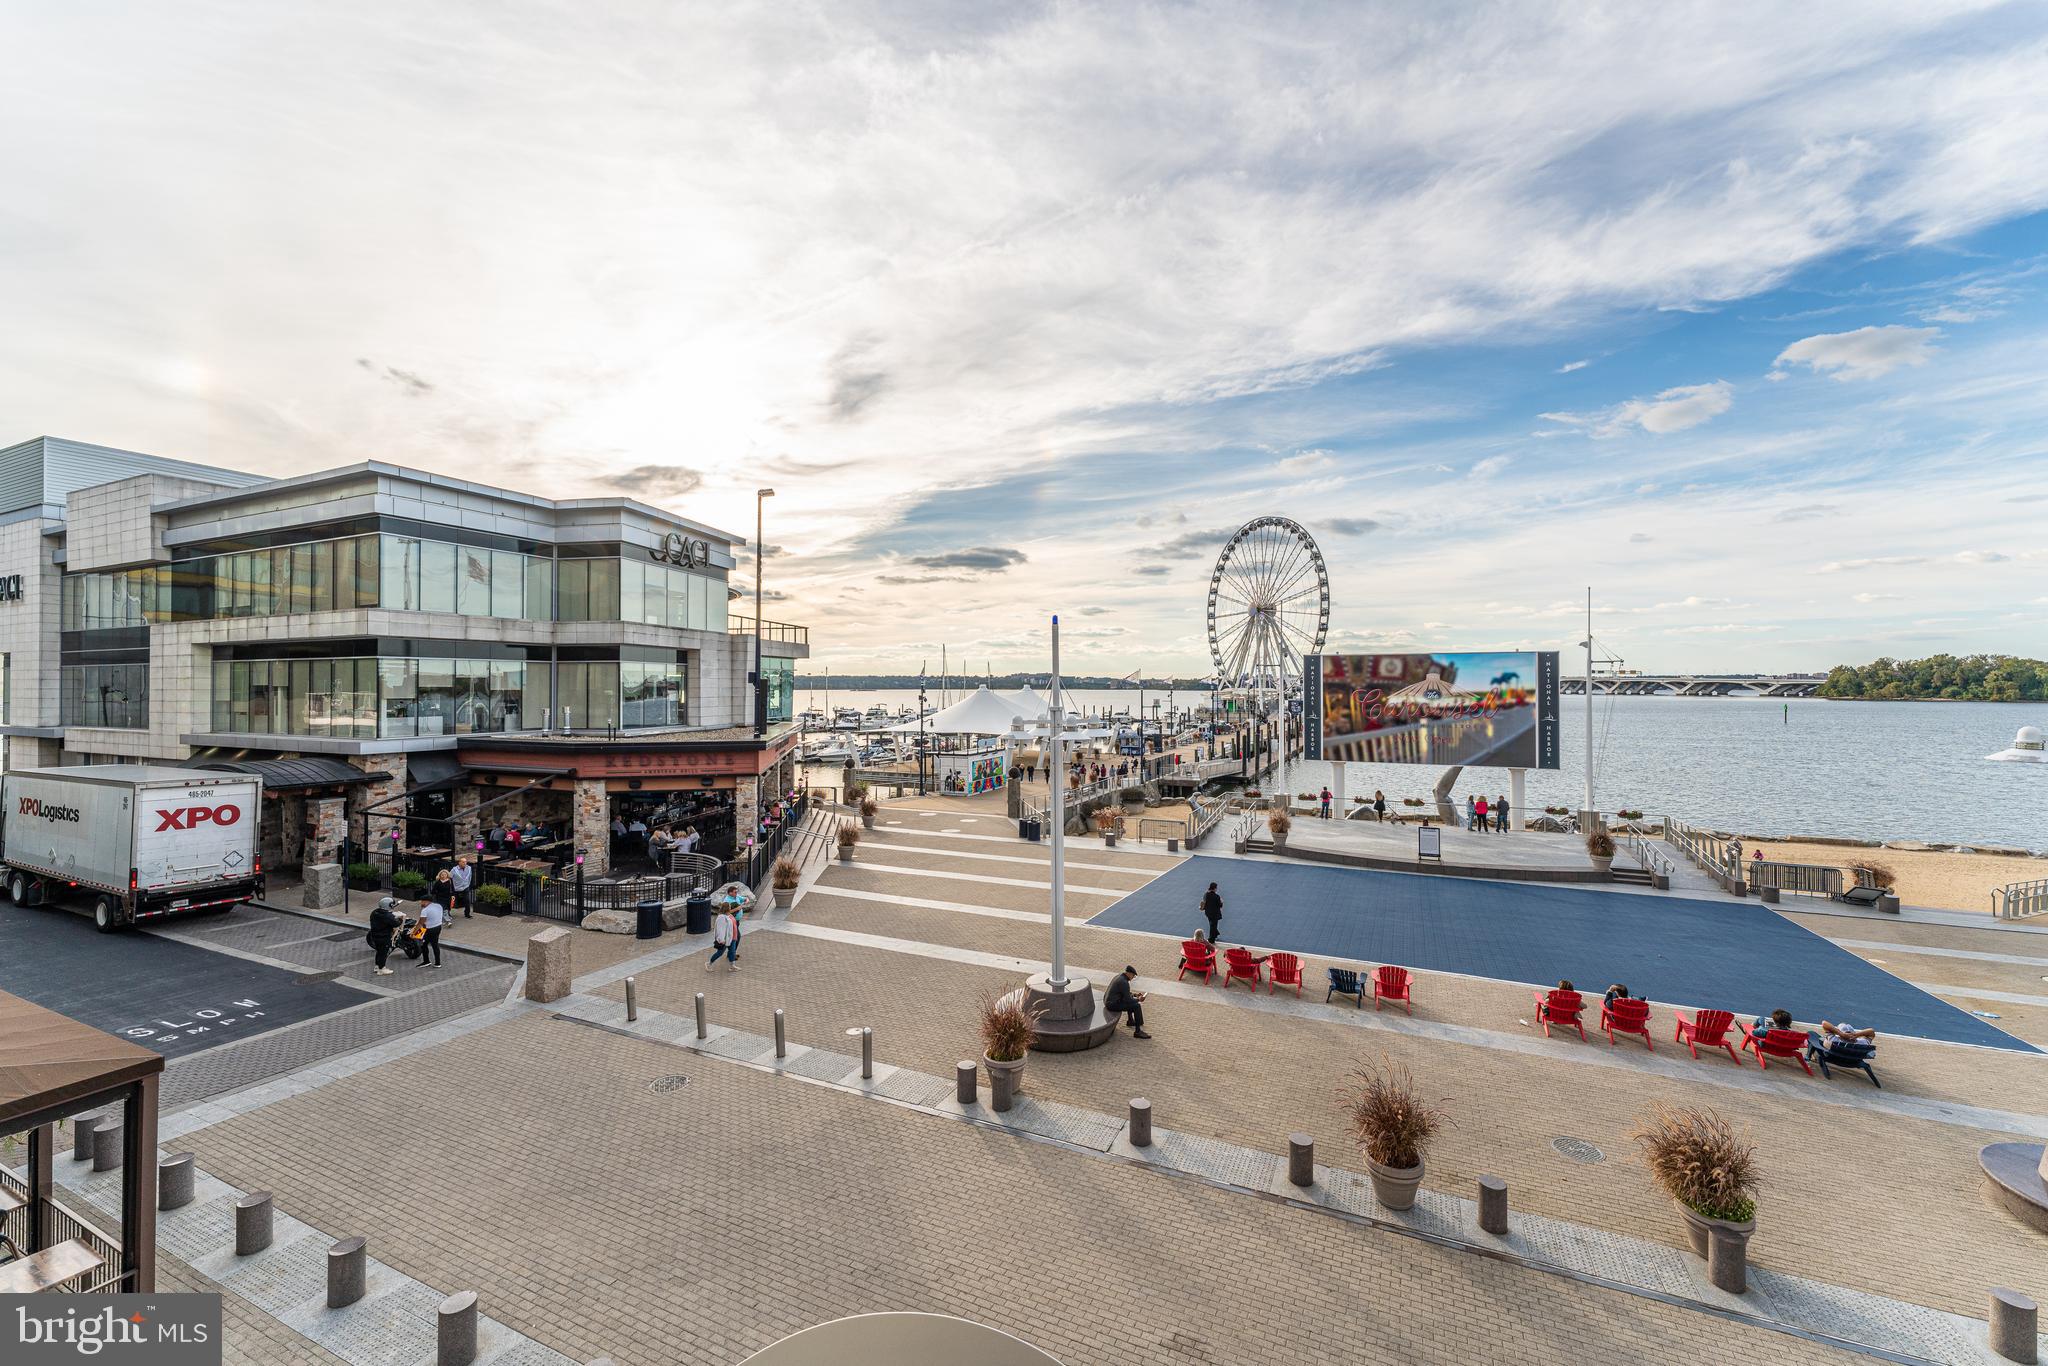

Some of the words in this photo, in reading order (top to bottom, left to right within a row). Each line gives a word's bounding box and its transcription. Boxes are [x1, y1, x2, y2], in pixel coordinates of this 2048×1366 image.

[665, 532, 711, 568] CACI
[1351, 687, 1501, 720] Carousel
[606, 753, 735, 767] REDSTONE
[154, 804, 241, 832] XPO
[127, 999, 261, 1037] SLOW
